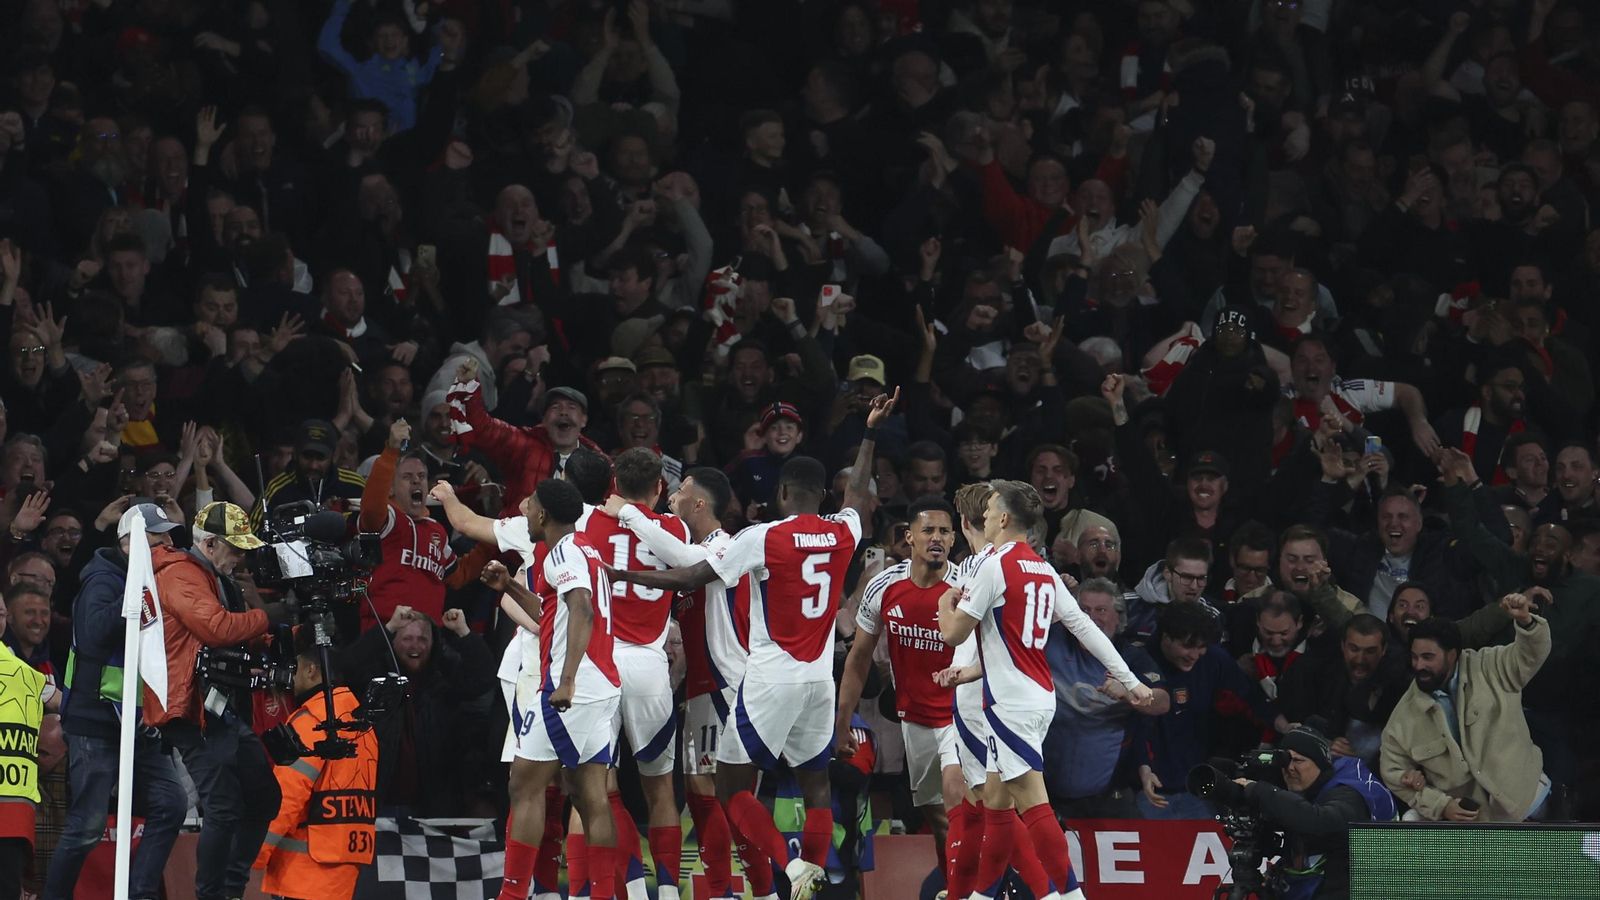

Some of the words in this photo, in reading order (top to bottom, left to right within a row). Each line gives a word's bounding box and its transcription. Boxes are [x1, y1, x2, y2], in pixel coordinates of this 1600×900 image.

[1219, 311, 1246, 327] AFC
[793, 532, 838, 548] THOMAS
[429, 542, 442, 562] Fly
[801, 552, 832, 619] 5
[1022, 581, 1055, 650] 19
[899, 636, 912, 648] FLY
[914, 639, 944, 653] BETTER
[701, 725, 717, 752] 11
